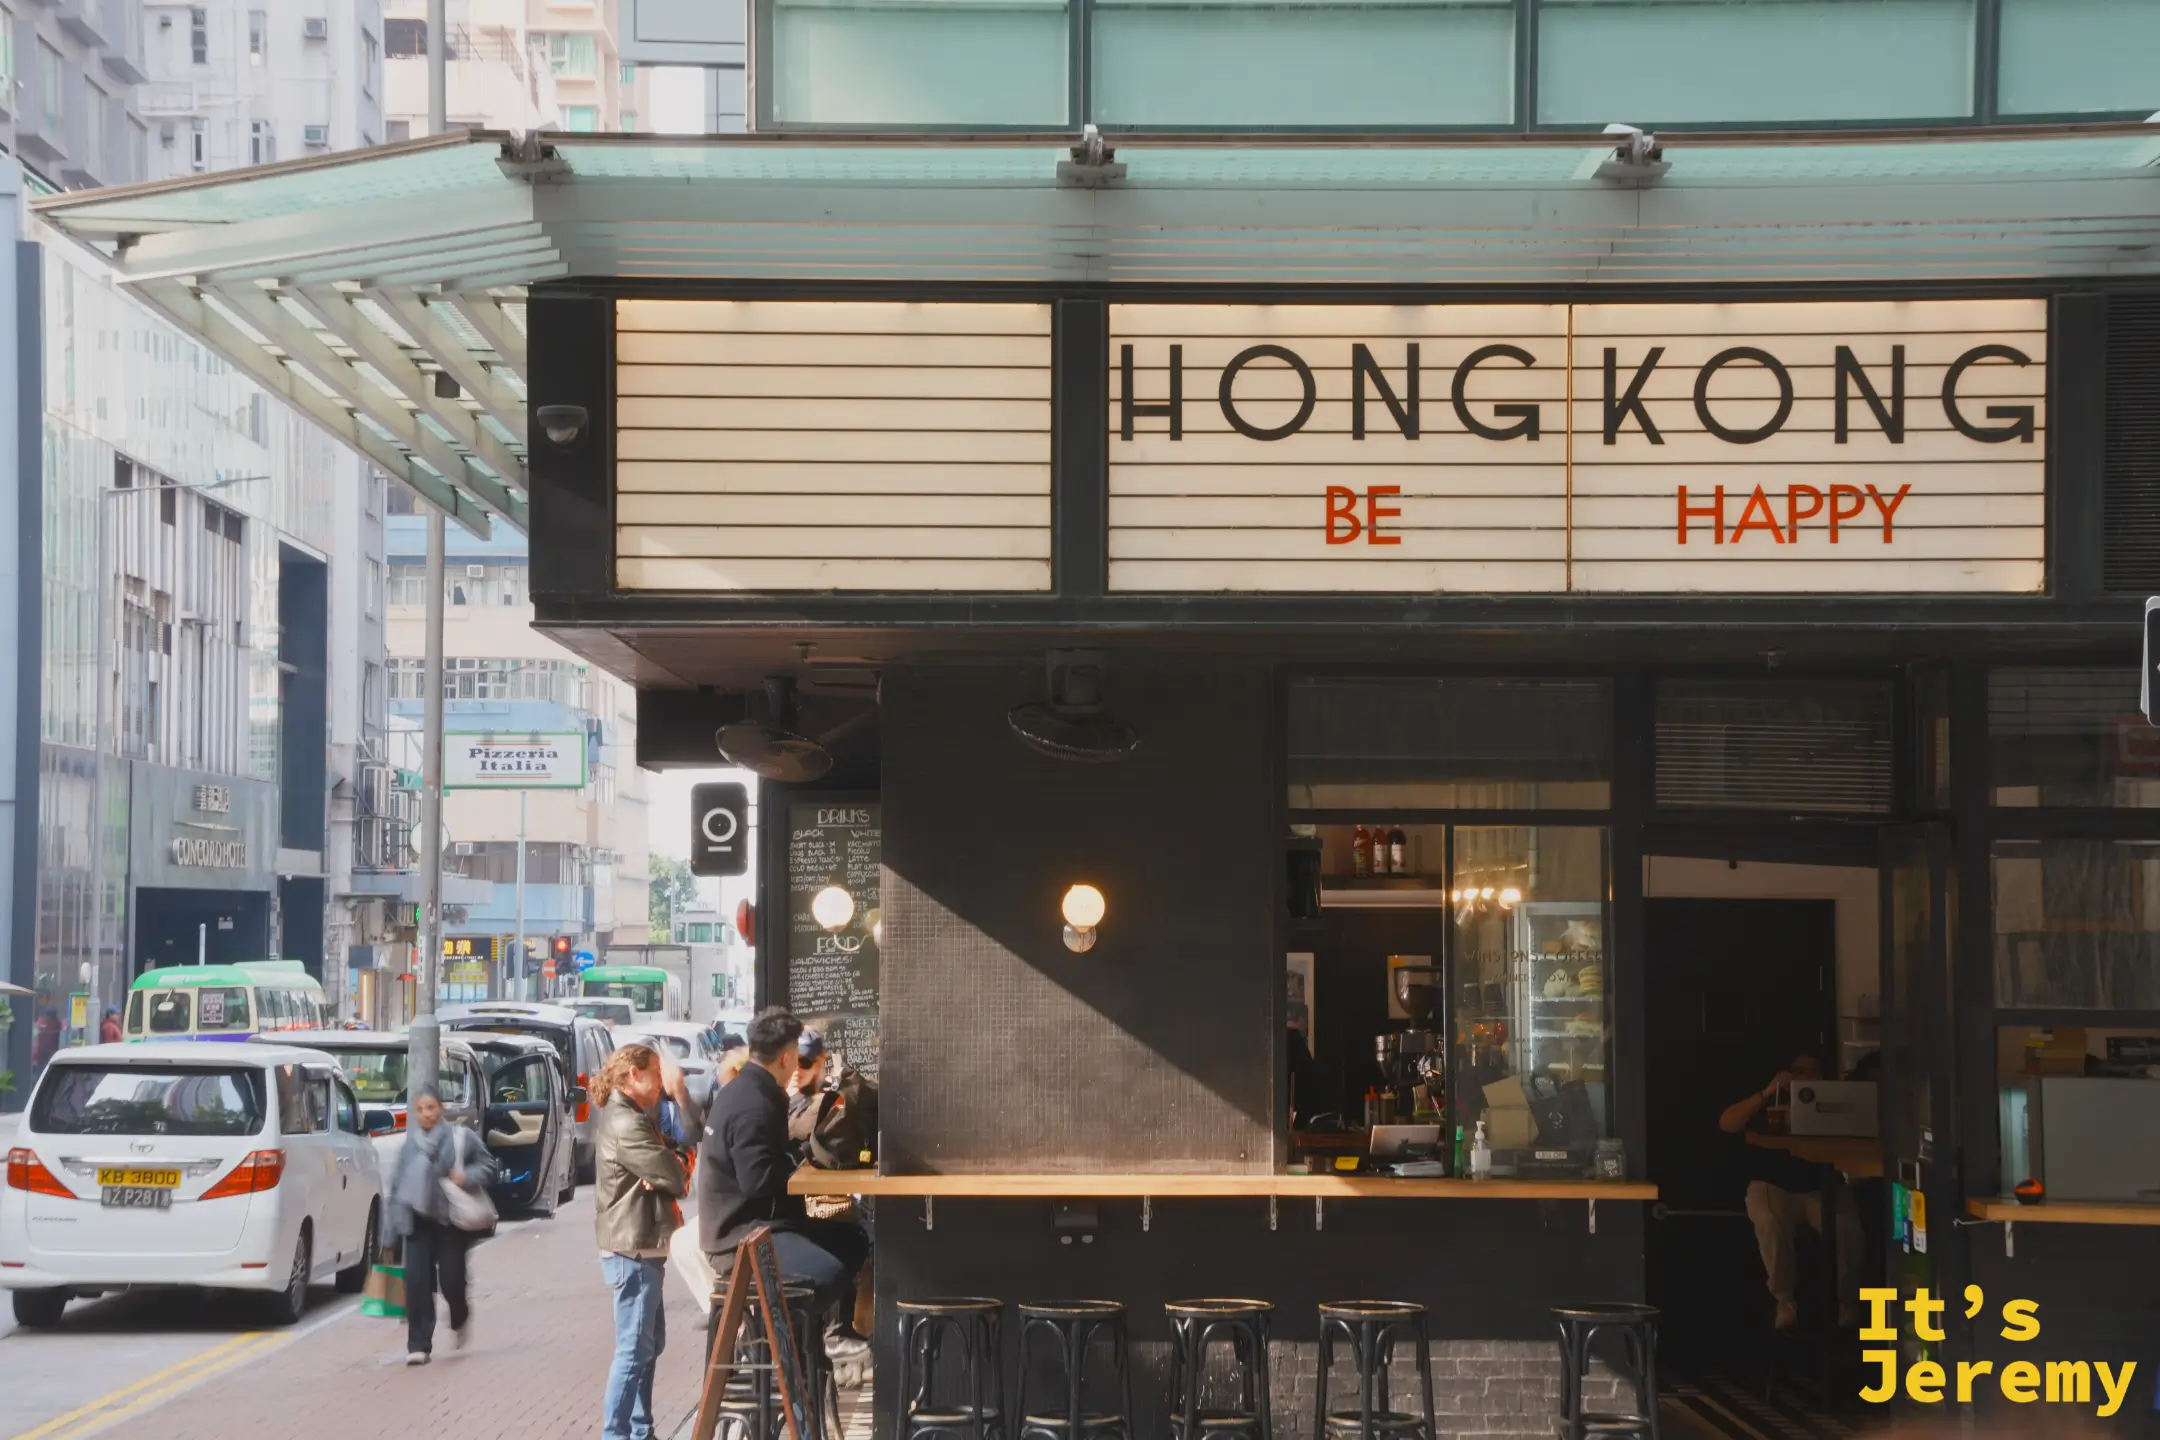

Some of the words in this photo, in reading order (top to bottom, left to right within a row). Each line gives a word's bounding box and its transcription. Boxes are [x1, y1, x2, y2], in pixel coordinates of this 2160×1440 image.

[1121, 342, 1539, 442] HONG
[1603, 344, 2035, 445] KONG
[1326, 485, 1401, 545] BE
[1677, 483, 1912, 545] HAPPY
[469, 748, 558, 759] Pizzeria
[480, 761, 547, 771] Italia
[818, 809, 870, 824] DRINKS
[793, 829, 825, 839] BLACK
[851, 830, 881, 838] WHITE
[173, 838, 222, 867] CONCORD
[817, 936, 860, 952] FOOD
[1464, 951, 1539, 962] WINSONS
[101, 1169, 124, 1184] KB
[130, 1171, 177, 1185] 3800
